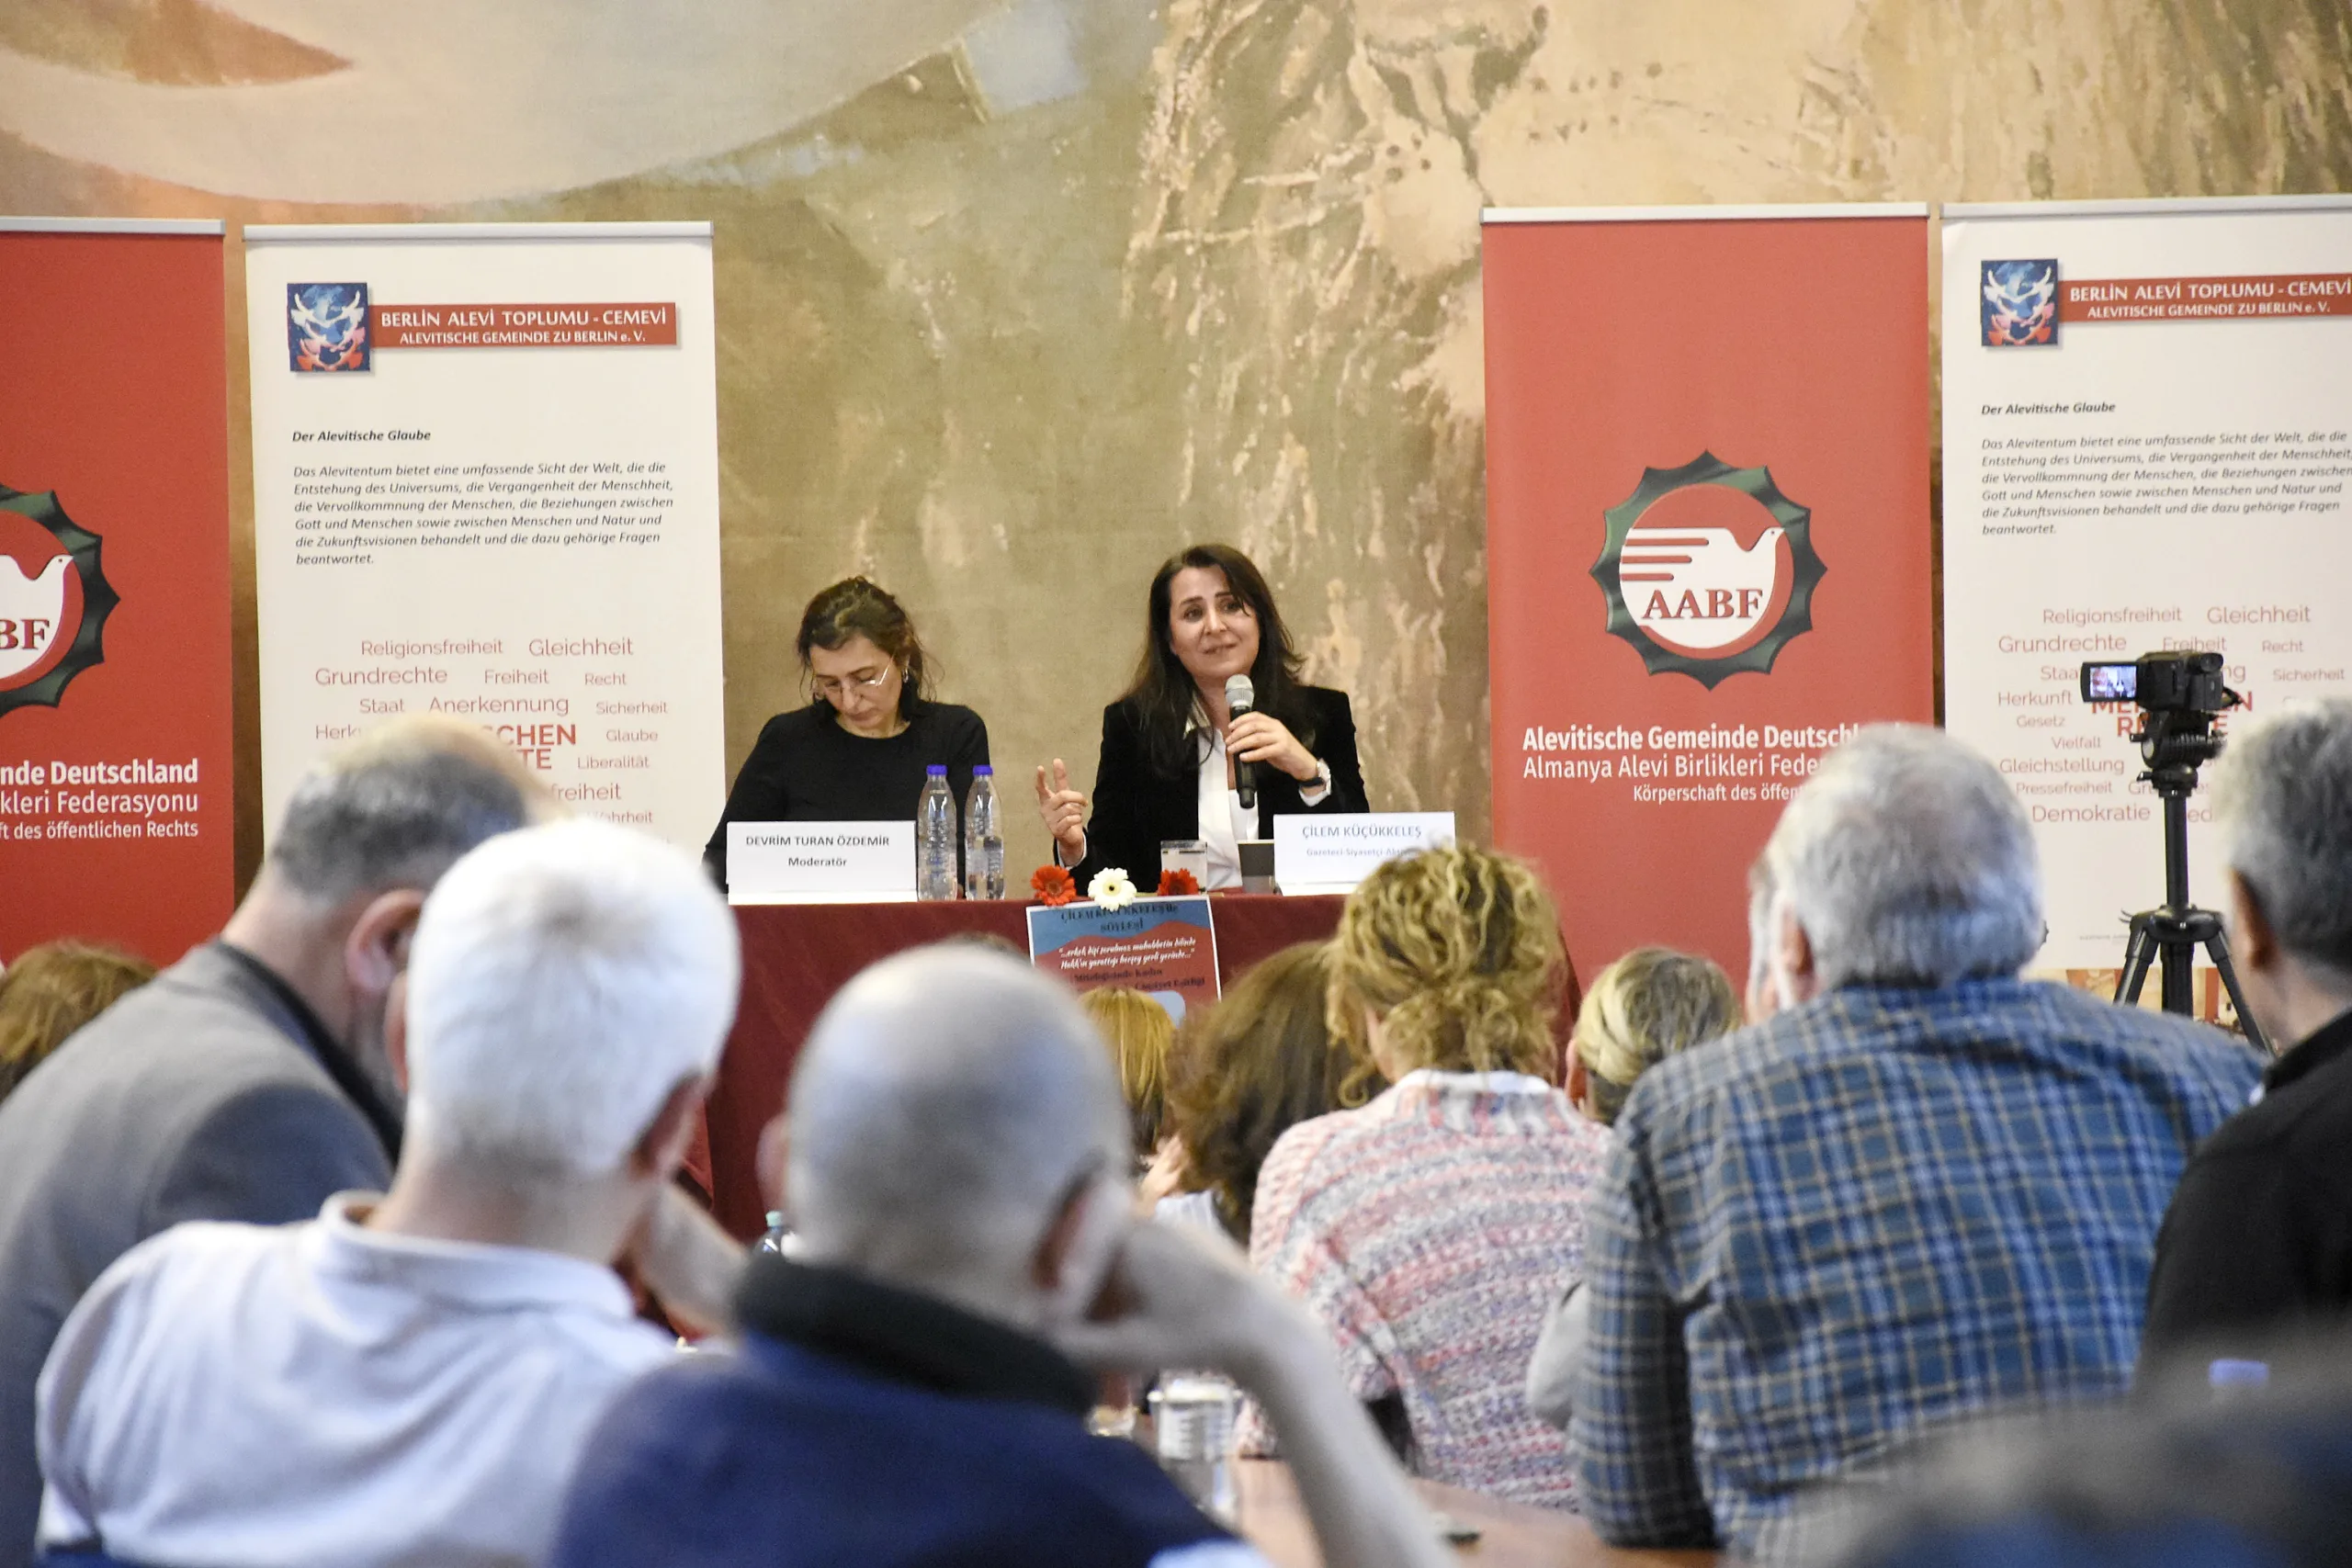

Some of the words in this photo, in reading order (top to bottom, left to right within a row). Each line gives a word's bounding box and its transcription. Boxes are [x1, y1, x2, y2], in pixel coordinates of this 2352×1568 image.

[2188, 282, 2274, 299] TOPLUMU
[502, 310, 589, 326] TOPLUMU
[2087, 305, 2165, 318] ALEVITISCHE
[2167, 304, 2234, 316] GEMEINDE
[2237, 303, 2256, 314] ZU
[2258, 301, 2301, 314] BERLIN
[400, 332, 479, 344] ALEVITISCHE
[482, 331, 550, 344] GEMEINDE
[553, 331, 571, 343] ZU
[574, 331, 617, 344] BERLIN
[620, 333, 631, 343] e.
[633, 330, 646, 342] V.
[1981, 404, 2003, 415] Der
[2005, 402, 2070, 415] Alevitische
[2073, 401, 2116, 413] Glaube
[292, 431, 314, 442] Der
[317, 430, 384, 442] Alevitische
[388, 429, 431, 441] Glaube
[1982, 438, 2003, 450] Das
[2006, 437, 2077, 449] Alevitentum
[2080, 436, 2114, 448] bietet
[2117, 436, 2142, 447] eine
[2145, 434, 2216, 448] umfassende
[2220, 433, 2247, 445] Sicht
[2250, 432, 2270, 445] der
[2307, 431, 2326, 443] die
[2329, 431, 2347, 443] die
[1982, 455, 2047, 468] Entstehung
[2050, 454, 2070, 466] des
[2148, 452, 2166, 463] die
[2170, 450, 2256, 465] Vergangenheit
[2258, 449, 2278, 461] der
[293, 466, 316, 479] Das
[319, 466, 392, 478] Alevitentum
[395, 464, 430, 477] bietet
[434, 464, 459, 476] eine
[462, 463, 534, 478] umfassende
[537, 462, 566, 475] Sicht
[569, 462, 589, 474] der
[593, 461, 623, 474] Welt,
[627, 461, 645, 473] die
[648, 461, 666, 473] die
[1982, 472, 1999, 484] die
[2003, 470, 2109, 484] Vervollkommnung
[2110, 469, 2131, 481] der
[2200, 468, 2219, 479] die
[2222, 467, 2297, 480] Beziehungen
[2300, 465, 2352, 478] zwischen
[294, 483, 362, 497] Entstehung
[365, 482, 386, 494] des
[390, 481, 462, 494] Universums,
[466, 481, 484, 493] die
[488, 479, 574, 495] Vergangenheit
[578, 479, 597, 491] der
[601, 479, 673, 491] Menschheit,
[294, 501, 312, 513] die
[316, 500, 424, 513] Vervollkommnung
[428, 499, 448, 511] der
[451, 498, 515, 511] Menschen,
[519, 498, 537, 510] die
[541, 497, 616, 511] Beziehungen
[620, 496, 673, 508] zwischen
[295, 518, 322, 530] Gott
[324, 518, 348, 530] und
[351, 517, 413, 529] Menschen
[416, 517, 451, 528] sowie
[454, 515, 507, 528] zwischen
[511, 514, 572, 527] Menschen
[575, 514, 599, 526] und
[602, 514, 636, 526] Natur
[639, 513, 662, 525] und
[295, 536, 314, 547] die
[316, 535, 417, 549] Zukunftsvisionen
[421, 533, 481, 546] behandelt
[484, 533, 507, 545] und
[510, 533, 528, 545] die
[531, 533, 560, 545] dazu
[563, 532, 616, 547] gehörige
[619, 532, 661, 545] Fragen
[296, 553, 374, 565] beantwortet.
[1641, 588, 1762, 619] AABF
[2042, 607, 2182, 626] Religionsfreiheit
[2207, 605, 2311, 624] Gleichheit
[361, 638, 503, 658] Religionsfreiheit
[528, 637, 633, 657] Gleichheit
[1998, 634, 2127, 654] Grundrechte
[2163, 637, 2227, 652] Freiheit
[2262, 638, 2304, 653] Recht
[315, 666, 447, 686] Grundrechte
[484, 668, 548, 684] Freiheit
[584, 671, 627, 686] Recht
[2041, 665, 2079, 682] Staa
[2273, 668, 2345, 682] Sicherheit
[359, 697, 404, 714] Staat
[429, 695, 569, 717] Anerkennung
[1997, 690, 2073, 706] Herkunft
[596, 701, 667, 715] Sicherheit
[2016, 714, 2065, 728] Gesetz
[497, 723, 577, 746] CHEN
[605, 728, 659, 743] Glaube
[1522, 724, 1644, 751] Alevitische
[1647, 722, 1759, 750] Gemeinde
[1764, 723, 1859, 749] Deutschl
[2051, 736, 2101, 750] Vielfalt
[51, 757, 198, 785] Deutschland
[577, 755, 650, 770] Liberalität
[1523, 754, 1612, 784] Almanya
[1618, 753, 1668, 778] Alevi
[1675, 752, 1763, 777] Birlikleri
[1999, 757, 2125, 777] Gleichstellung
[551, 783, 622, 801] freiheit
[1634, 783, 1727, 806] Körperschaft
[1730, 783, 1757, 801] des
[2015, 780, 2112, 795] Pressefreiheit
[57, 789, 198, 818] Federasyonu
[2031, 803, 2151, 823] Demokratie
[14, 823, 41, 840] des
[47, 820, 141, 840] öffentlichen
[147, 820, 198, 838] Rechts
[1302, 824, 1340, 840] ÇİLEM
[1343, 823, 1421, 840] KÜÇÜKKELEŞ
[746, 834, 791, 846] DEVRİM
[796, 836, 833, 847] TURAN
[837, 834, 889, 846] ÖZDEMİR
[788, 856, 847, 867] Moderatör
